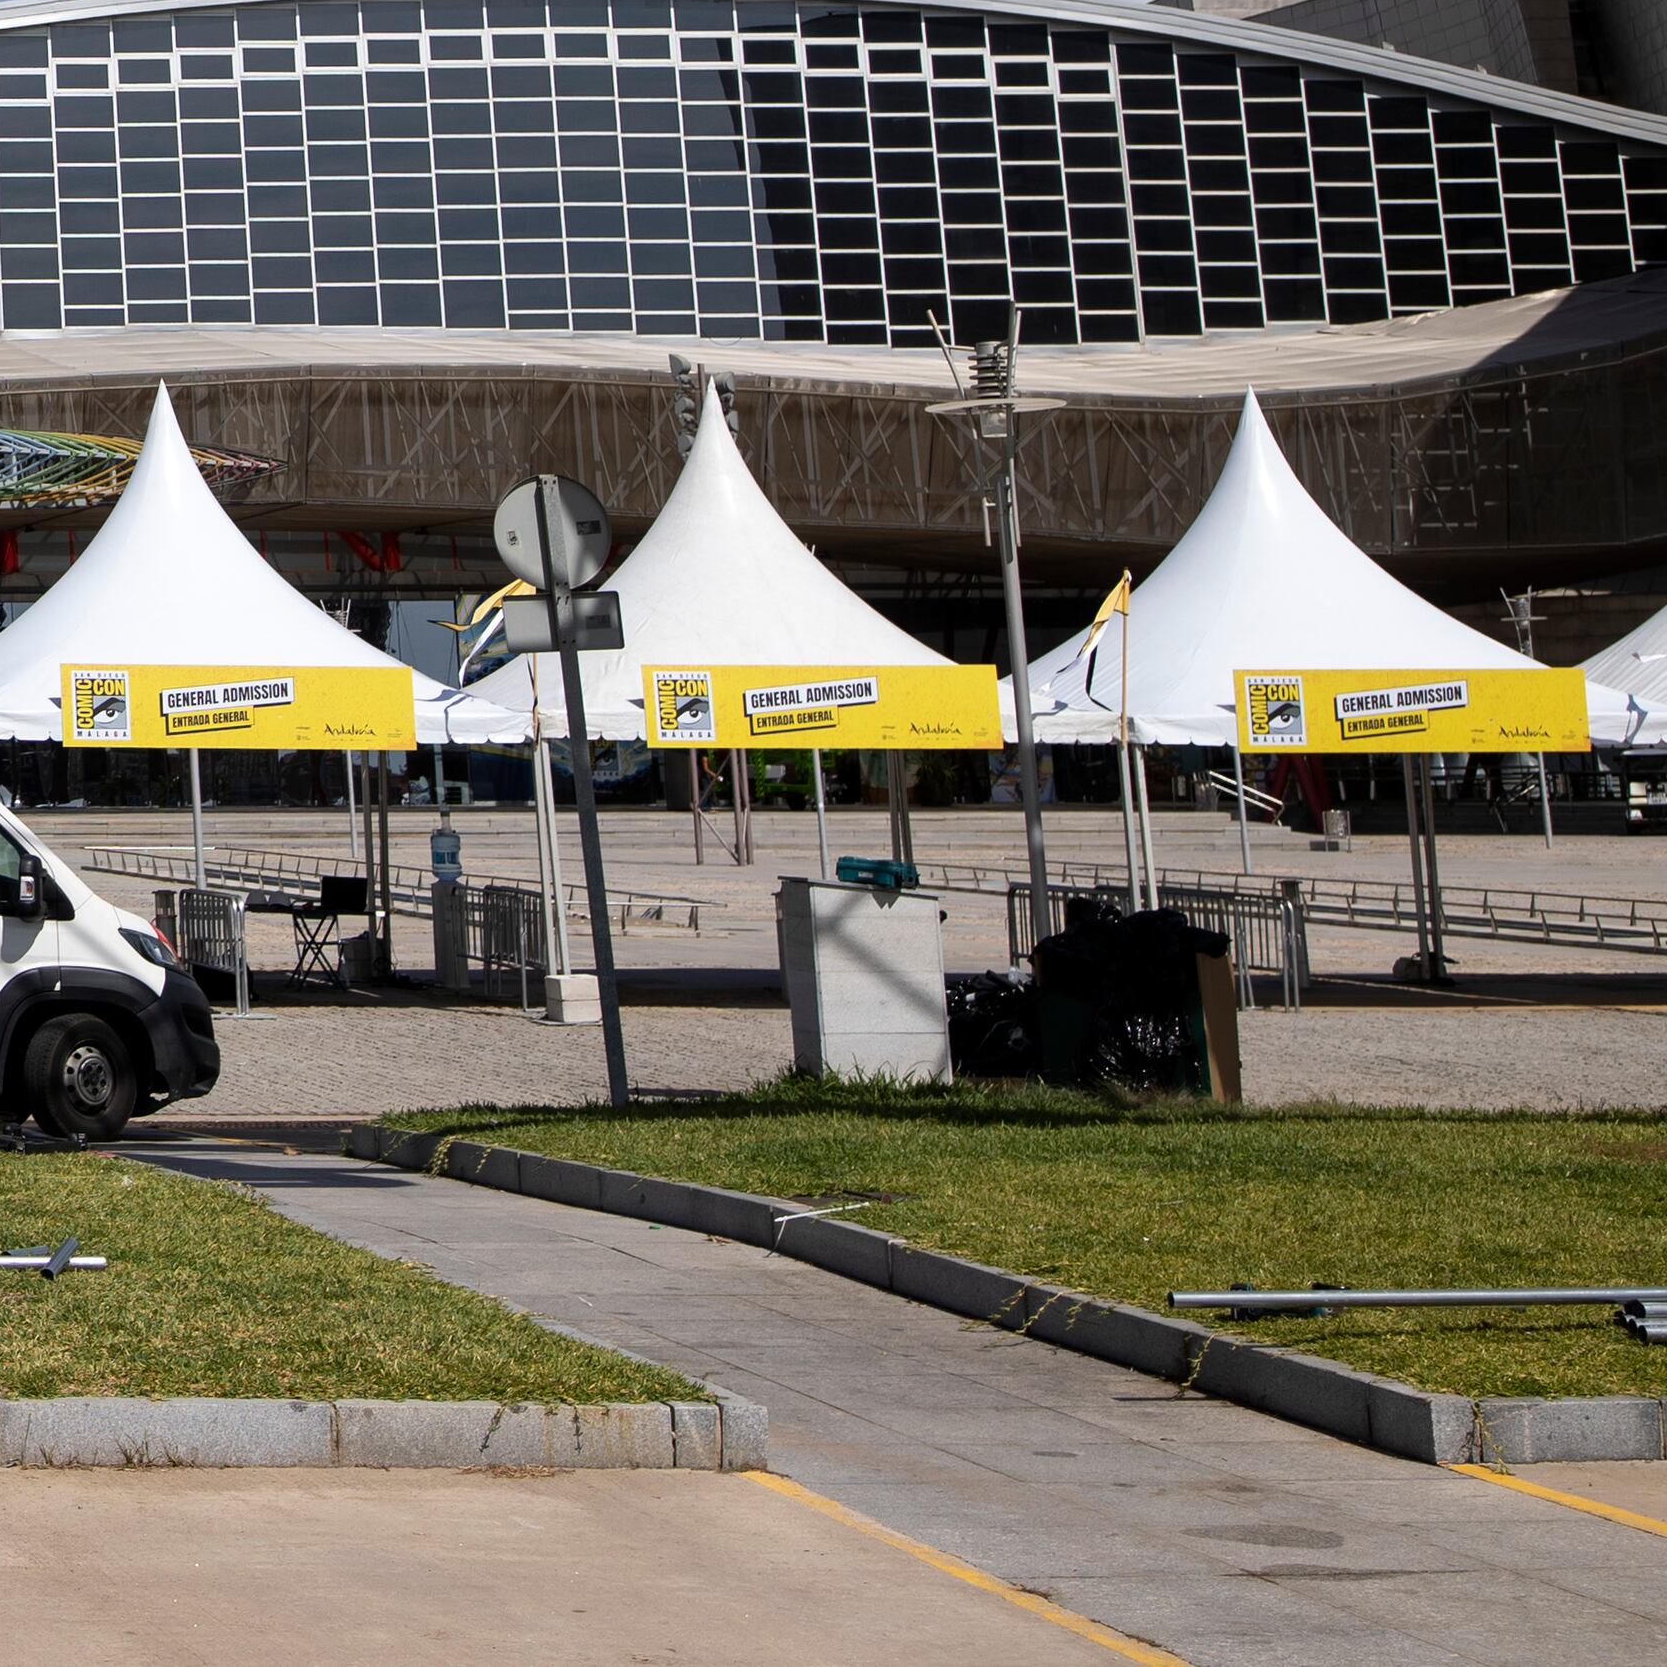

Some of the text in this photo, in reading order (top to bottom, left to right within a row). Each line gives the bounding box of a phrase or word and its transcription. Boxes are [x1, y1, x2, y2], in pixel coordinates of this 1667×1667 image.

[93, 678, 125, 696] CON
[167, 683, 289, 708] GENERAL ADMISSION
[676, 679, 708, 696] CON
[750, 682, 872, 708] GENERAL ADMISSION
[1267, 684, 1299, 701] CON
[77, 679, 94, 729] COMIC
[659, 680, 677, 730] COMIC
[1251, 685, 1268, 735] COMIC
[1342, 685, 1462, 713] GENERAL ADMISSION
[172, 709, 250, 728] ENTRADA GENERAL
[757, 710, 834, 729] ENTRADA GENERAL
[1348, 714, 1425, 733] ENTRADA GENERAL
